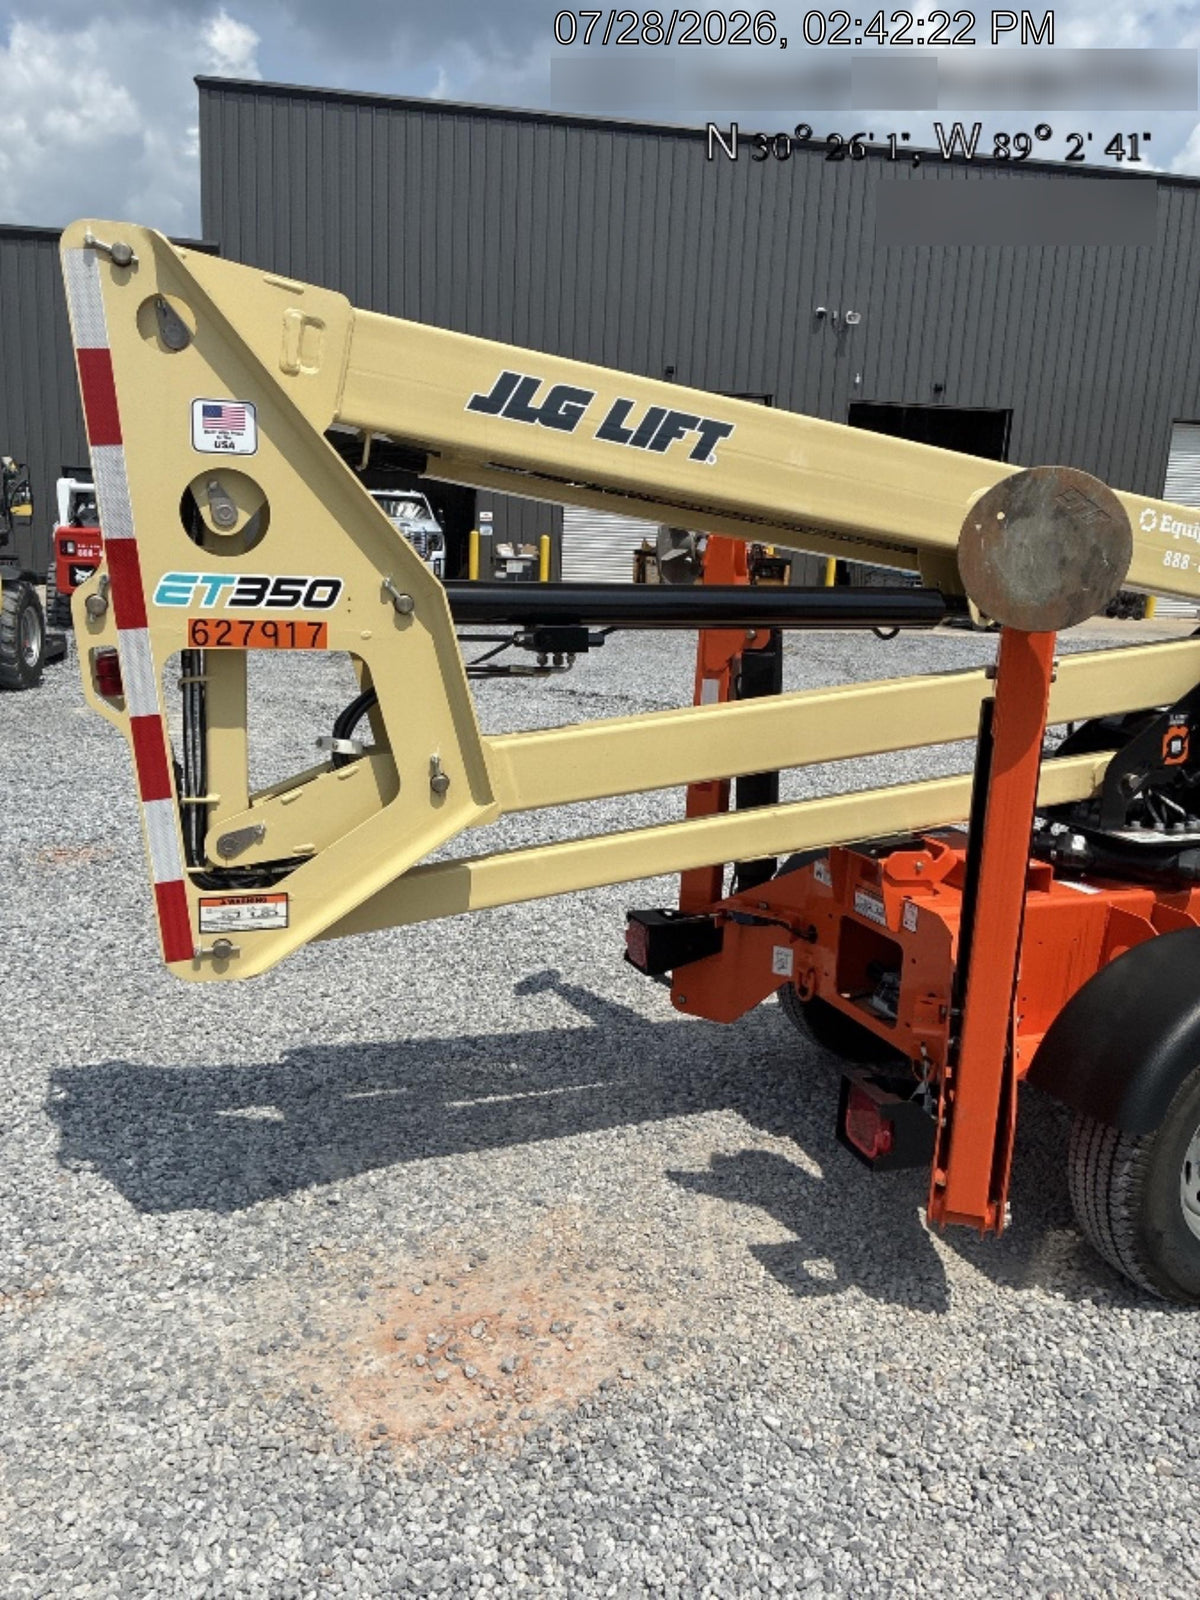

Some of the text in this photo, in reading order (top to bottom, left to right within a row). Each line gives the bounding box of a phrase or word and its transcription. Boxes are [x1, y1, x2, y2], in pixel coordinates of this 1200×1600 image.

[464, 370, 735, 463] JLG LIFT
[214, 440, 235, 450] USA
[152, 571, 344, 611] ET350
[191, 619, 322, 648] 627917
